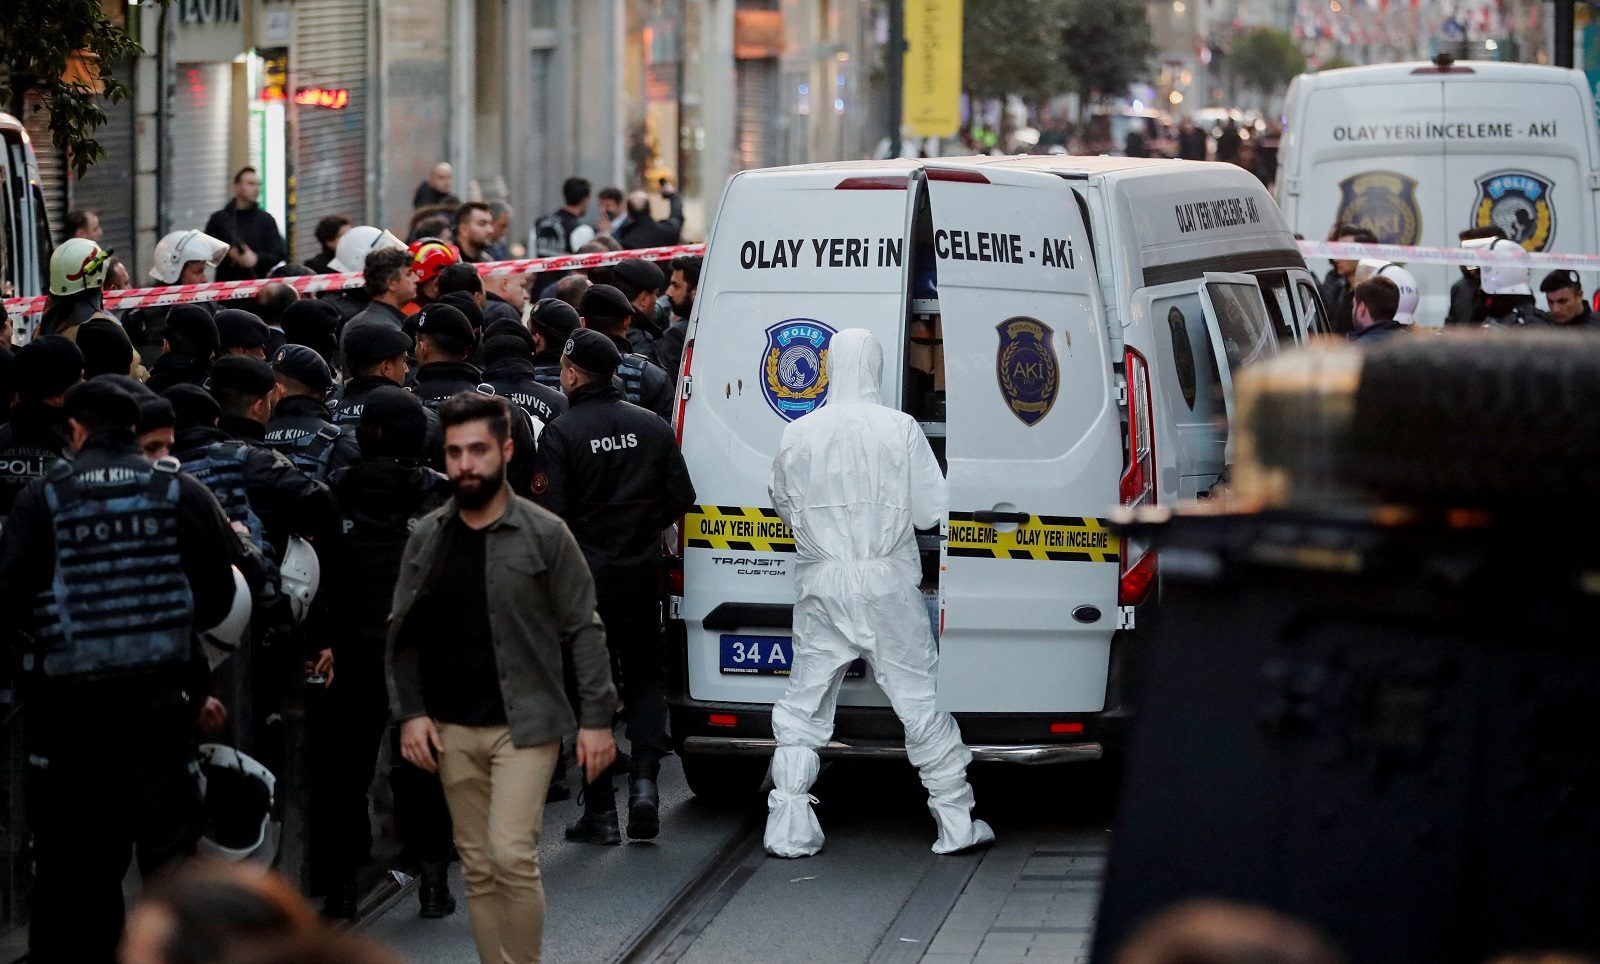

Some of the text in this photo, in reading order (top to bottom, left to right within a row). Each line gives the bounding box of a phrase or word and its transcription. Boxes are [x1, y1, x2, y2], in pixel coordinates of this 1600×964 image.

[1334, 125, 1379, 141] OLAY
[1383, 123, 1421, 140] YERİ
[1426, 122, 1513, 139] İNCELEME
[1528, 121, 1557, 138] AKİ
[1175, 203, 1197, 233] OLAY
[740, 239, 804, 270] OLAY
[934, 229, 1024, 264] CELEME
[511, 392, 553, 418] KUVVET
[700, 518, 727, 535] OLAY
[1016, 528, 1041, 546] OLAY
[732, 641, 787, 664] 34 A
